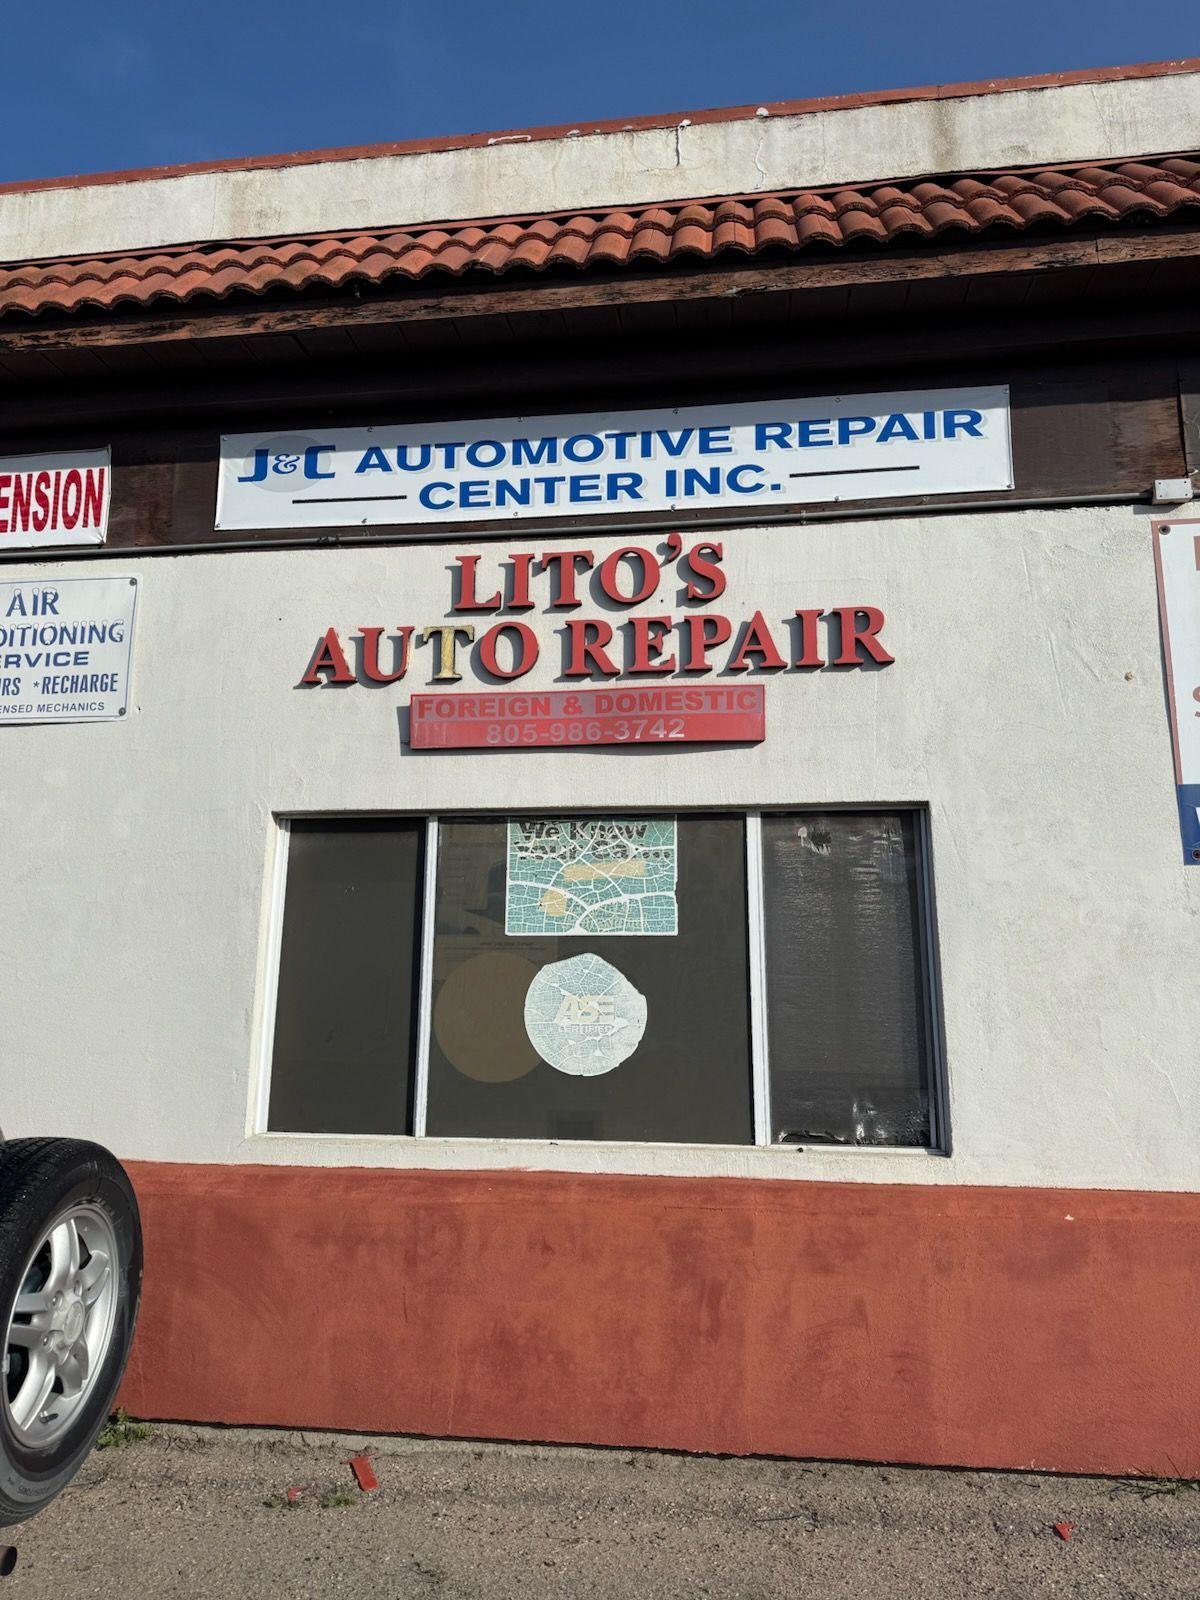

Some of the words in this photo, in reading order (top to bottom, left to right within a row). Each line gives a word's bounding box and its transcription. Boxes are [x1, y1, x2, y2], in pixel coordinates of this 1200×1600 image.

[238, 445, 336, 483] J&C
[355, 424, 733, 474] AUTOMOTIVE
[755, 409, 983, 451] REPAIR
[419, 472, 643, 510] CENTER
[665, 464, 781, 498] INC.
[454, 532, 726, 610] LITO'S
[6, 587, 59, 617] AIR
[302, 621, 539, 683] AUTO
[564, 606, 895, 676] REPAIR
[0, 651, 90, 669] RVICE
[0, 677, 21, 696] RS
[0, 703, 33, 714] NSED
[36, 702, 105, 713] MECHANICS
[418, 696, 549, 718] FOREIGN
[562, 695, 583, 716] &
[595, 690, 758, 715] DOMESTIC
[486, 718, 685, 744] 805-986-3742
[519, 821, 560, 840] We
[569, 821, 648, 840] Know
